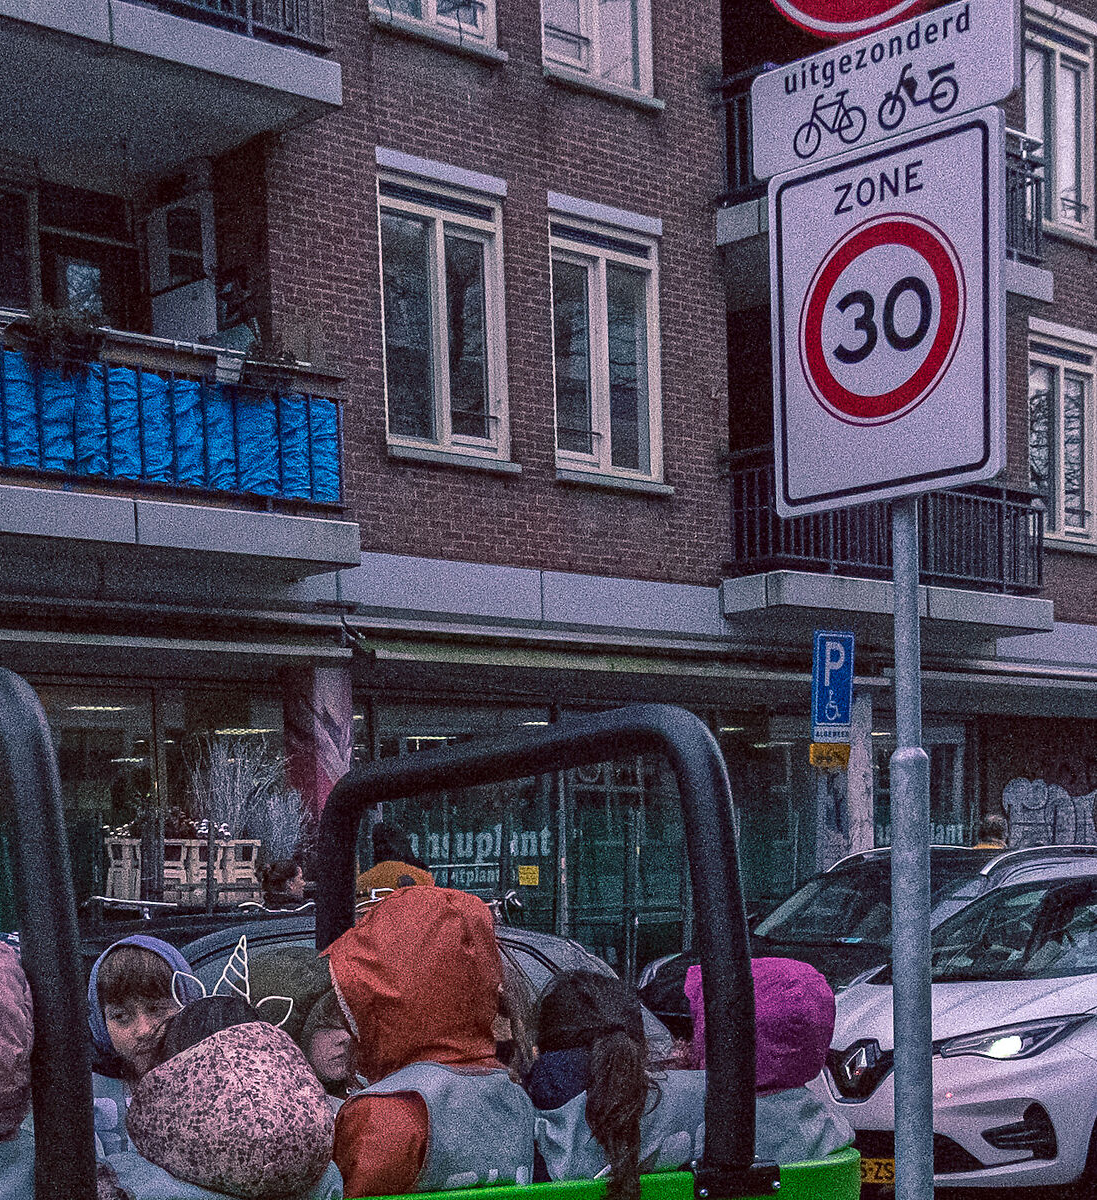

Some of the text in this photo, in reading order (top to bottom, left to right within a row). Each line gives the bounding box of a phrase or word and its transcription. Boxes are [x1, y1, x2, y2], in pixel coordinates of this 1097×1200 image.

[784, 7, 971, 95] uitgezonderd
[834, 160, 924, 215] ZONE
[833, 276, 932, 364] 30
[824, 641, 846, 687] P
